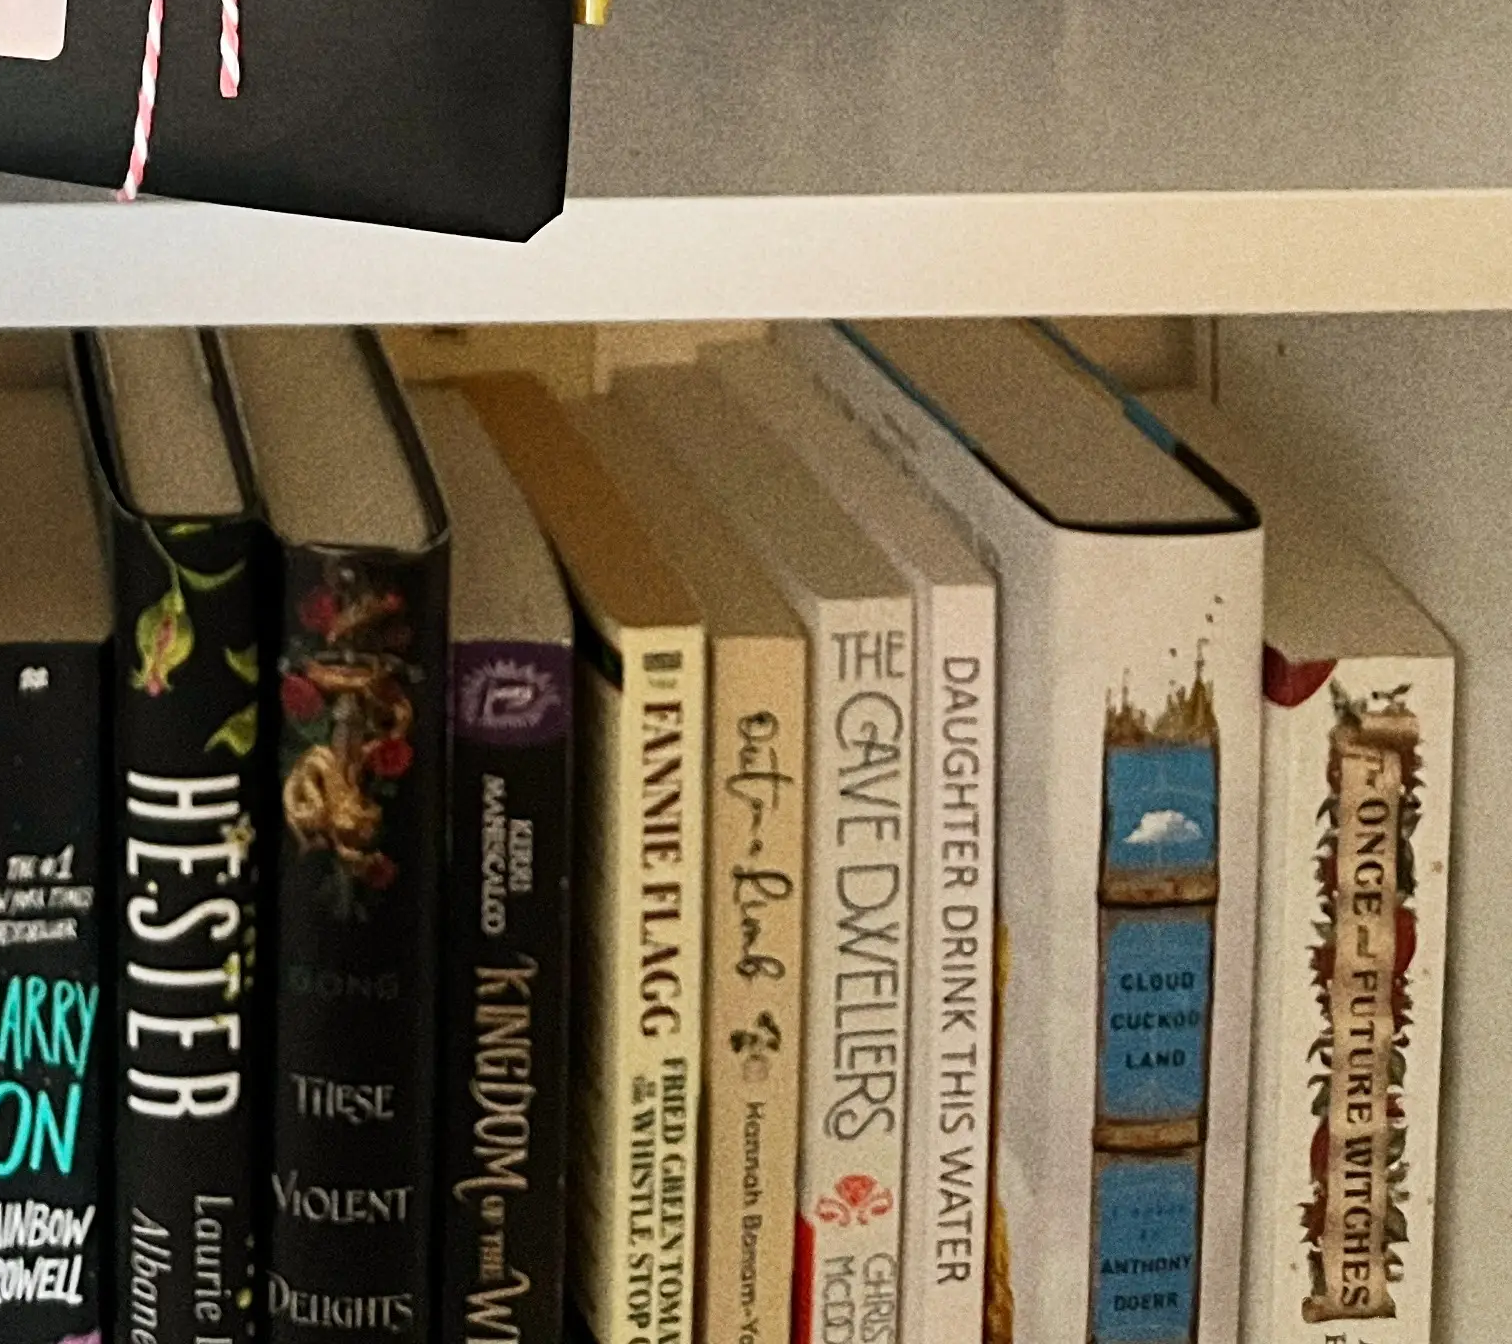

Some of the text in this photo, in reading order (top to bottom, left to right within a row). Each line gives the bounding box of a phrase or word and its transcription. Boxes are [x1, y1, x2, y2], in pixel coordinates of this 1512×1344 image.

[830, 628, 907, 683] THE
[642, 700, 685, 870] FANNIE
[640, 881, 684, 1039] FLAGG
[935, 655, 981, 1287] DAUGHTER DRINK THIS WATER
[1119, 970, 1195, 994] CLOUD
[1109, 1011, 1201, 1032] CUCKOO
[1124, 1049, 1187, 1072] LAND
[742, 1100, 768, 1211] Hannah
[1340, 969, 1380, 1309] FUTURE WITCHES
[626, 1252, 656, 1330] STOP
[1100, 1254, 1194, 1277] ANTHONY
